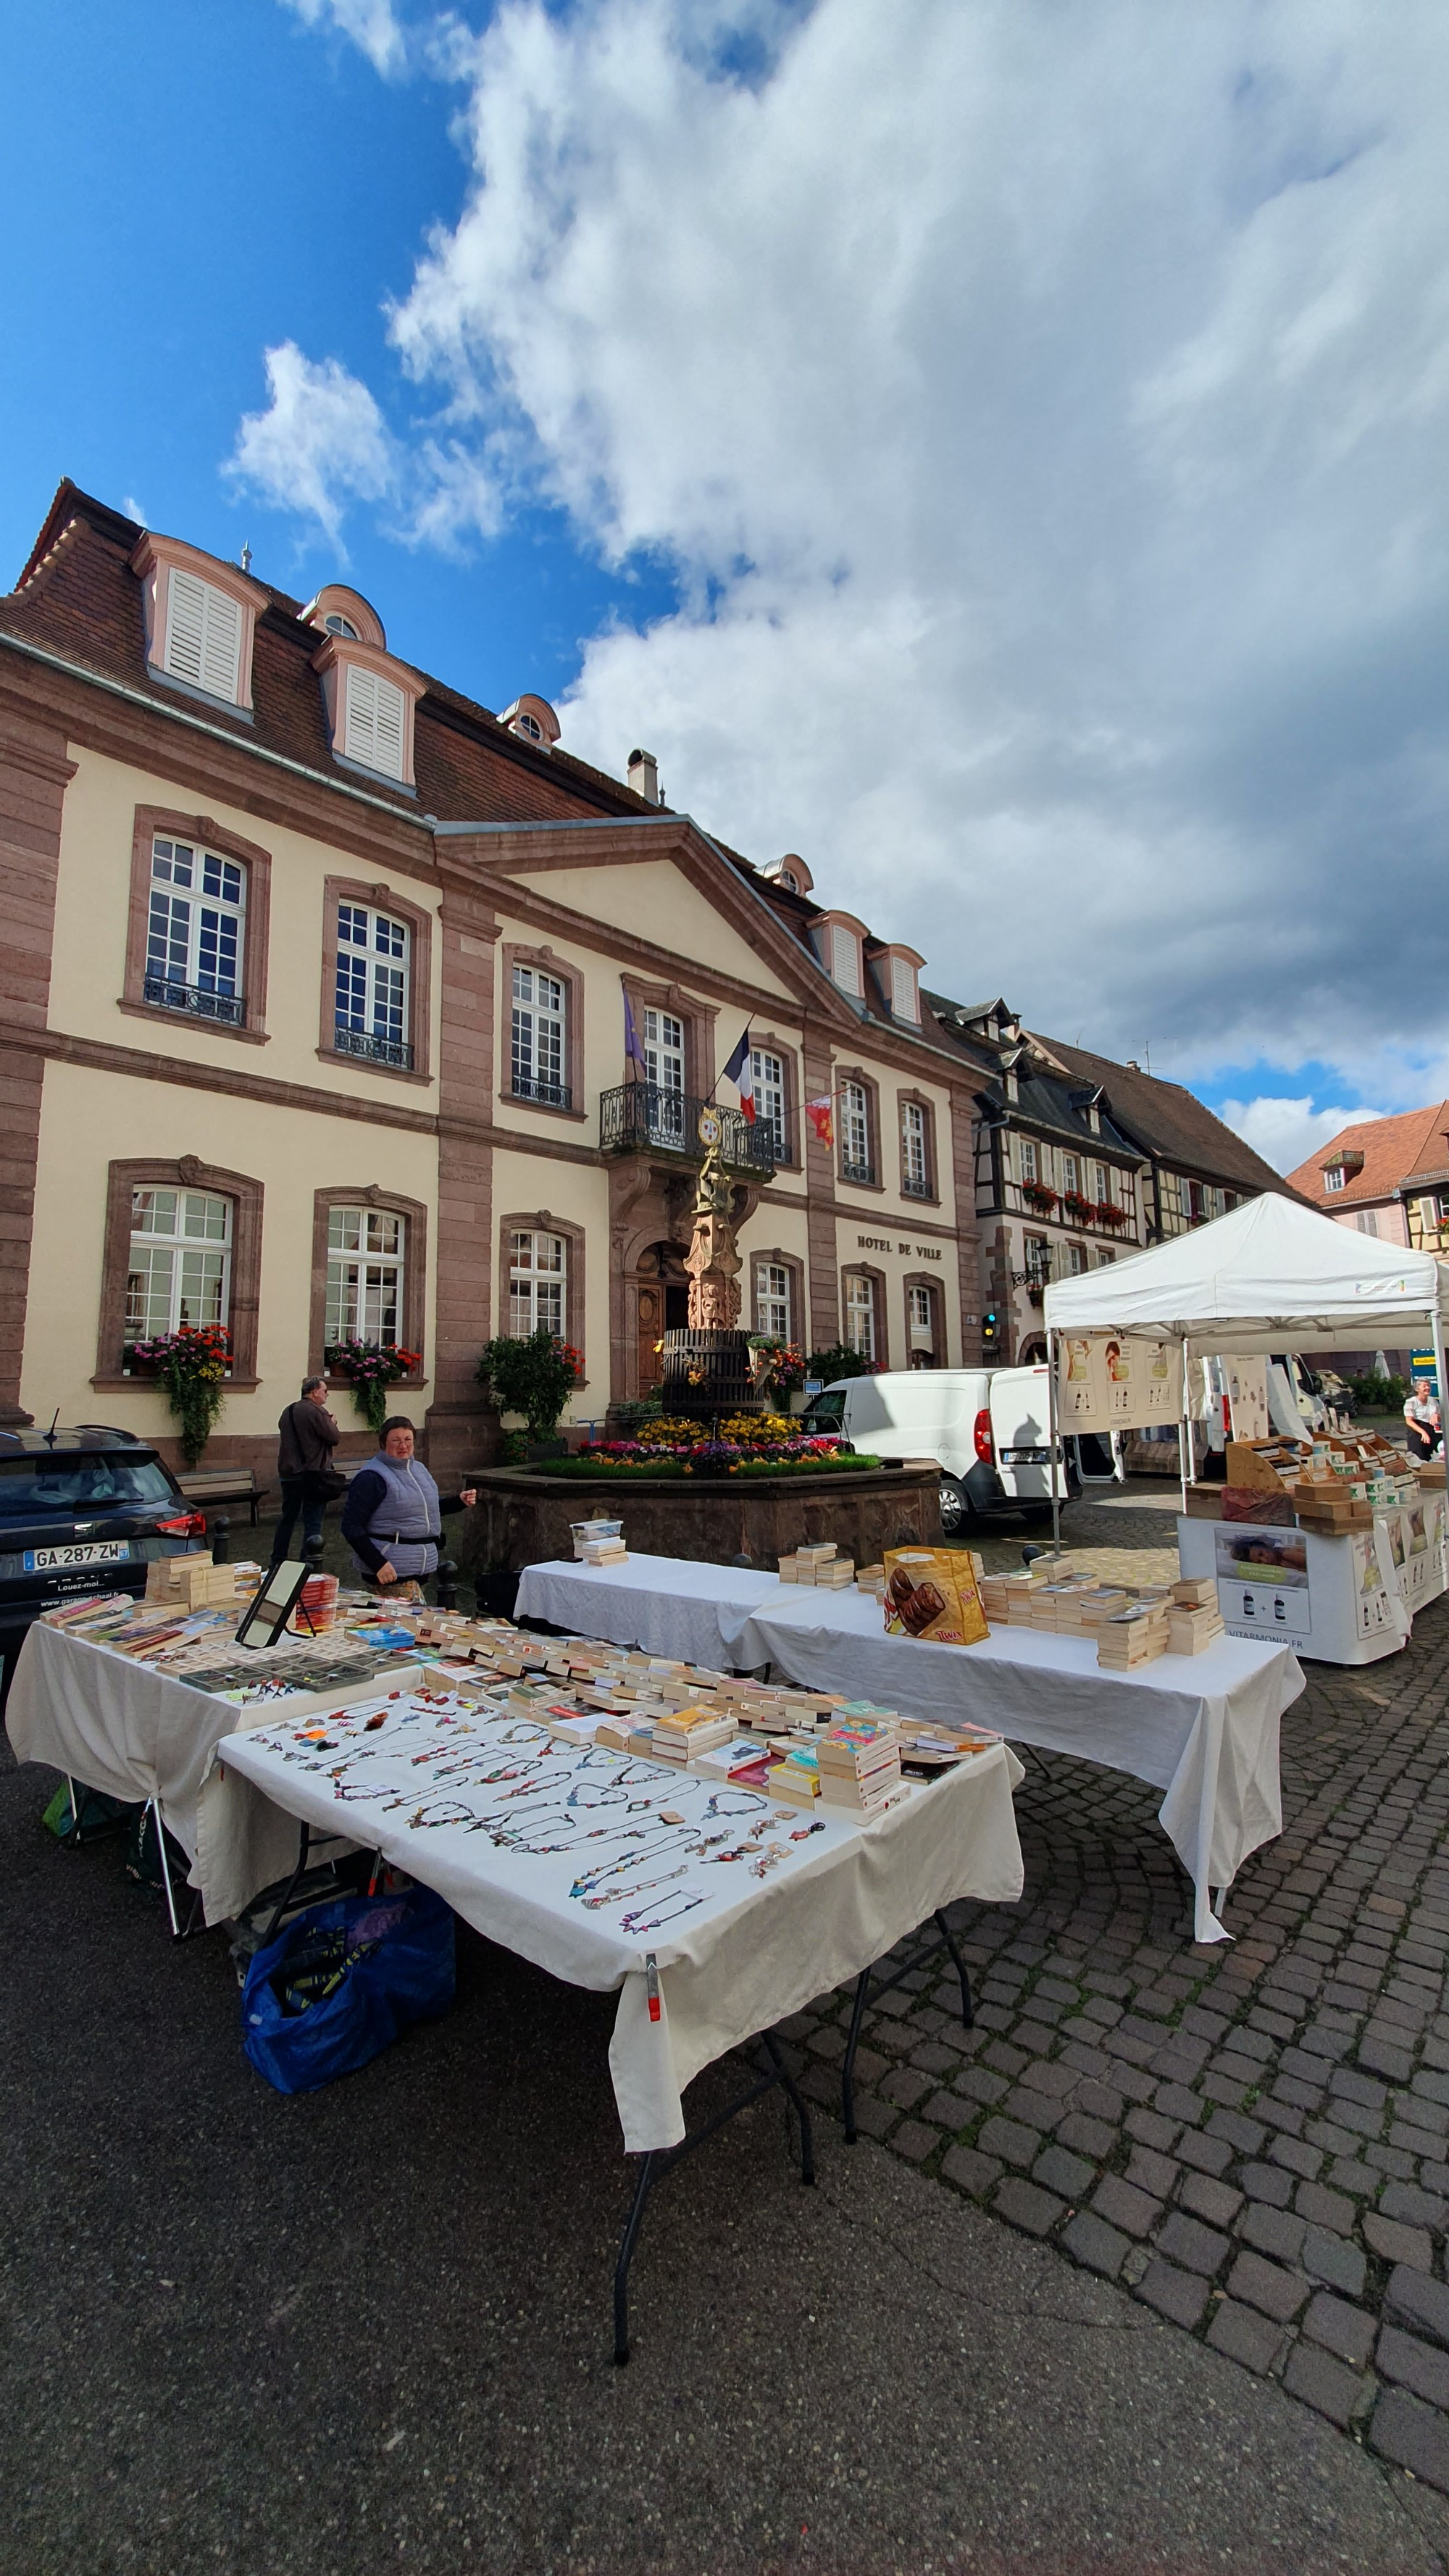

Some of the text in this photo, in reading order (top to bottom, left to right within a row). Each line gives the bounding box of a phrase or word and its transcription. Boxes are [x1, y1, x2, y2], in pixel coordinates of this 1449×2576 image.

[857, 1235, 942, 1260] HOTEL DE VILLE
[37, 1543, 118, 1567] GA-287-ZW
